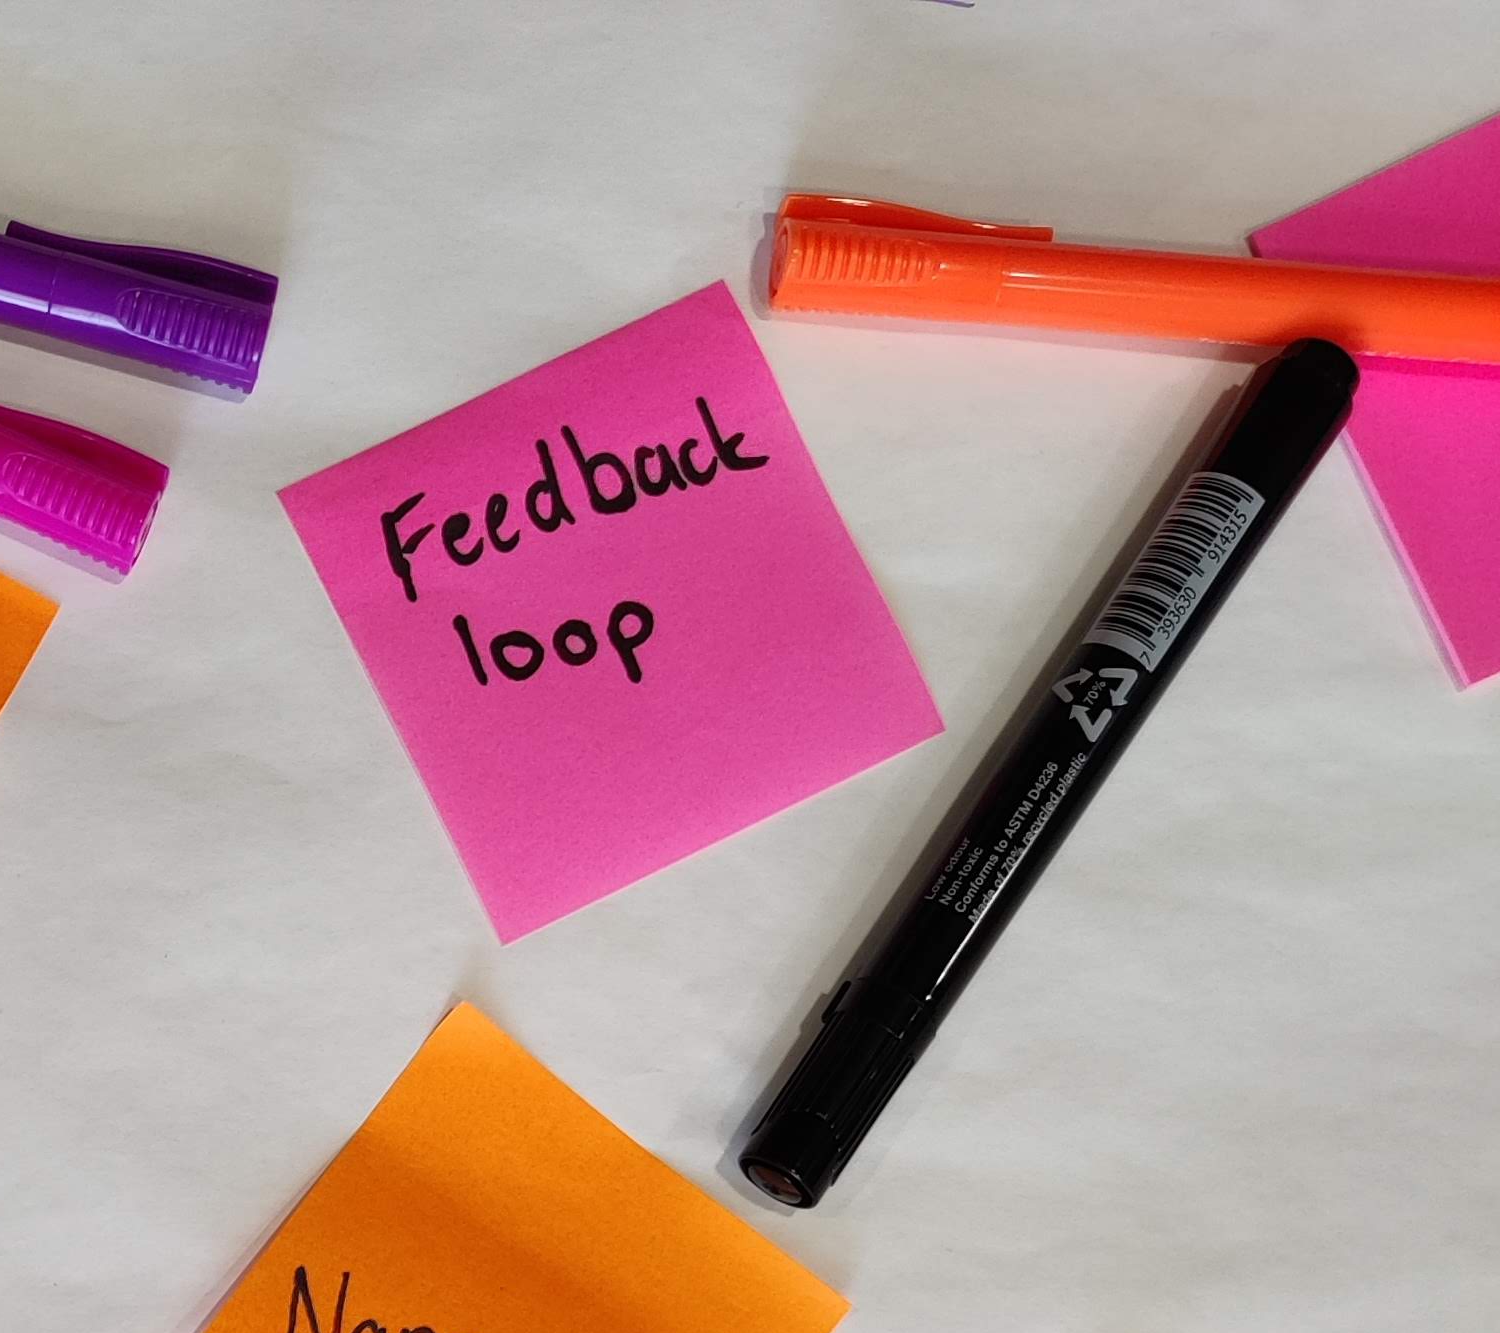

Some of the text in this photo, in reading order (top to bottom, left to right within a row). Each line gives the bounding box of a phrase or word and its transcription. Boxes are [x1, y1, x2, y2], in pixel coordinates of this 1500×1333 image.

[380, 396, 770, 602] Feedback
[453, 601, 654, 685] loop
[1139, 507, 1247, 665] 7 393630 914315
[1083, 681, 1106, 705] 70%
[924, 874, 947, 900] Low
[938, 847, 983, 906] Non-toxic
[954, 854, 999, 913] Conforms
[1004, 800, 1033, 839] ASTM
[1027, 762, 1058, 801] D4236
[968, 889, 998, 926] Made
[1001, 846, 1026, 876] 70%
[1022, 791, 1063, 848] recycled
[1056, 752, 1089, 796] plastic
